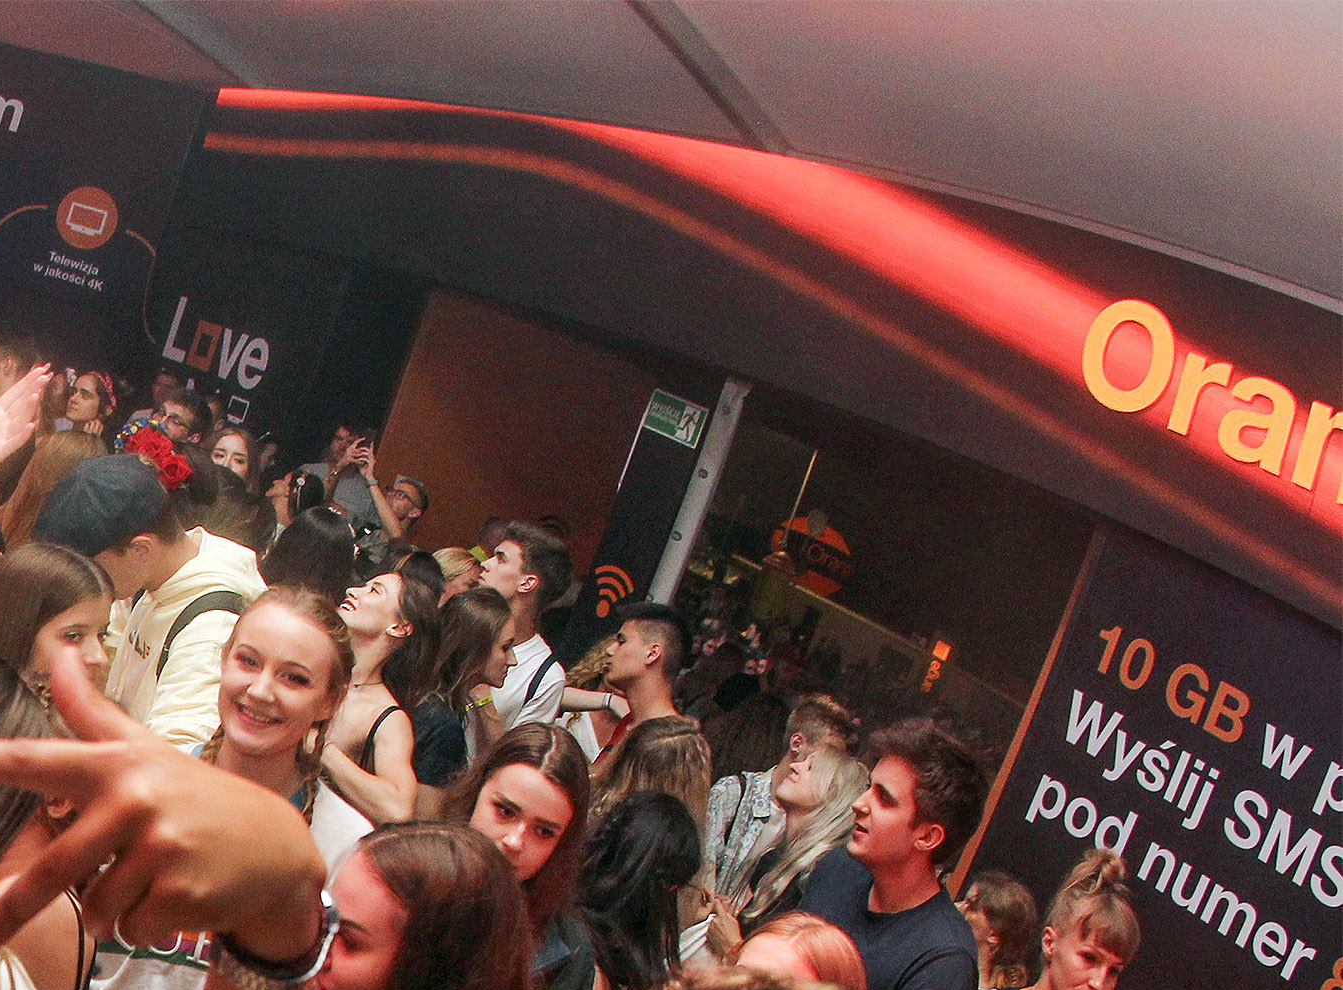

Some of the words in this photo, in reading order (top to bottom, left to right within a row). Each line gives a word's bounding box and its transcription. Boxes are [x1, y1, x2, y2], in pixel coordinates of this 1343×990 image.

[33, 264, 44, 273] w
[44, 265, 86, 286] jakości
[87, 278, 104, 291] 4K
[49, 250, 100, 276] Telewizja
[1095, 625, 1155, 690] 10
[1165, 661, 1251, 744] GB
[1261, 723, 1314, 781] w
[1064, 689, 1221, 830] Wyślij
[1223, 789, 1343, 907] SMS
[1025, 774, 1139, 857] pod
[1137, 837, 1318, 981] numer
